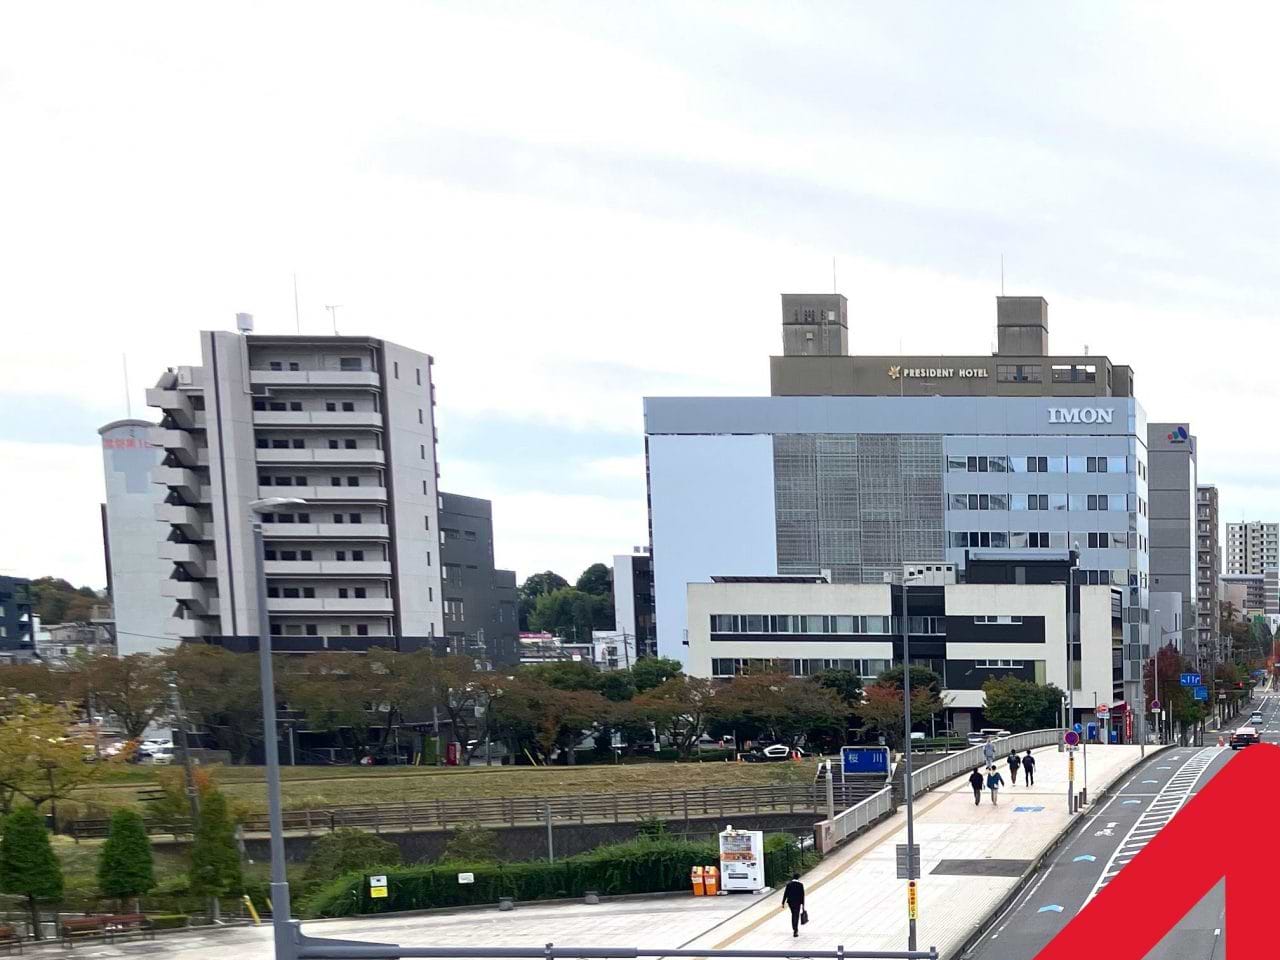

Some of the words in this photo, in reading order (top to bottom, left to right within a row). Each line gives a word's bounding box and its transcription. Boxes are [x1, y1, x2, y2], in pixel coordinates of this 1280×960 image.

[903, 368, 954, 378] PRESIDENT
[959, 368, 989, 378] HOTEL
[1048, 408, 1114, 425] IMON
